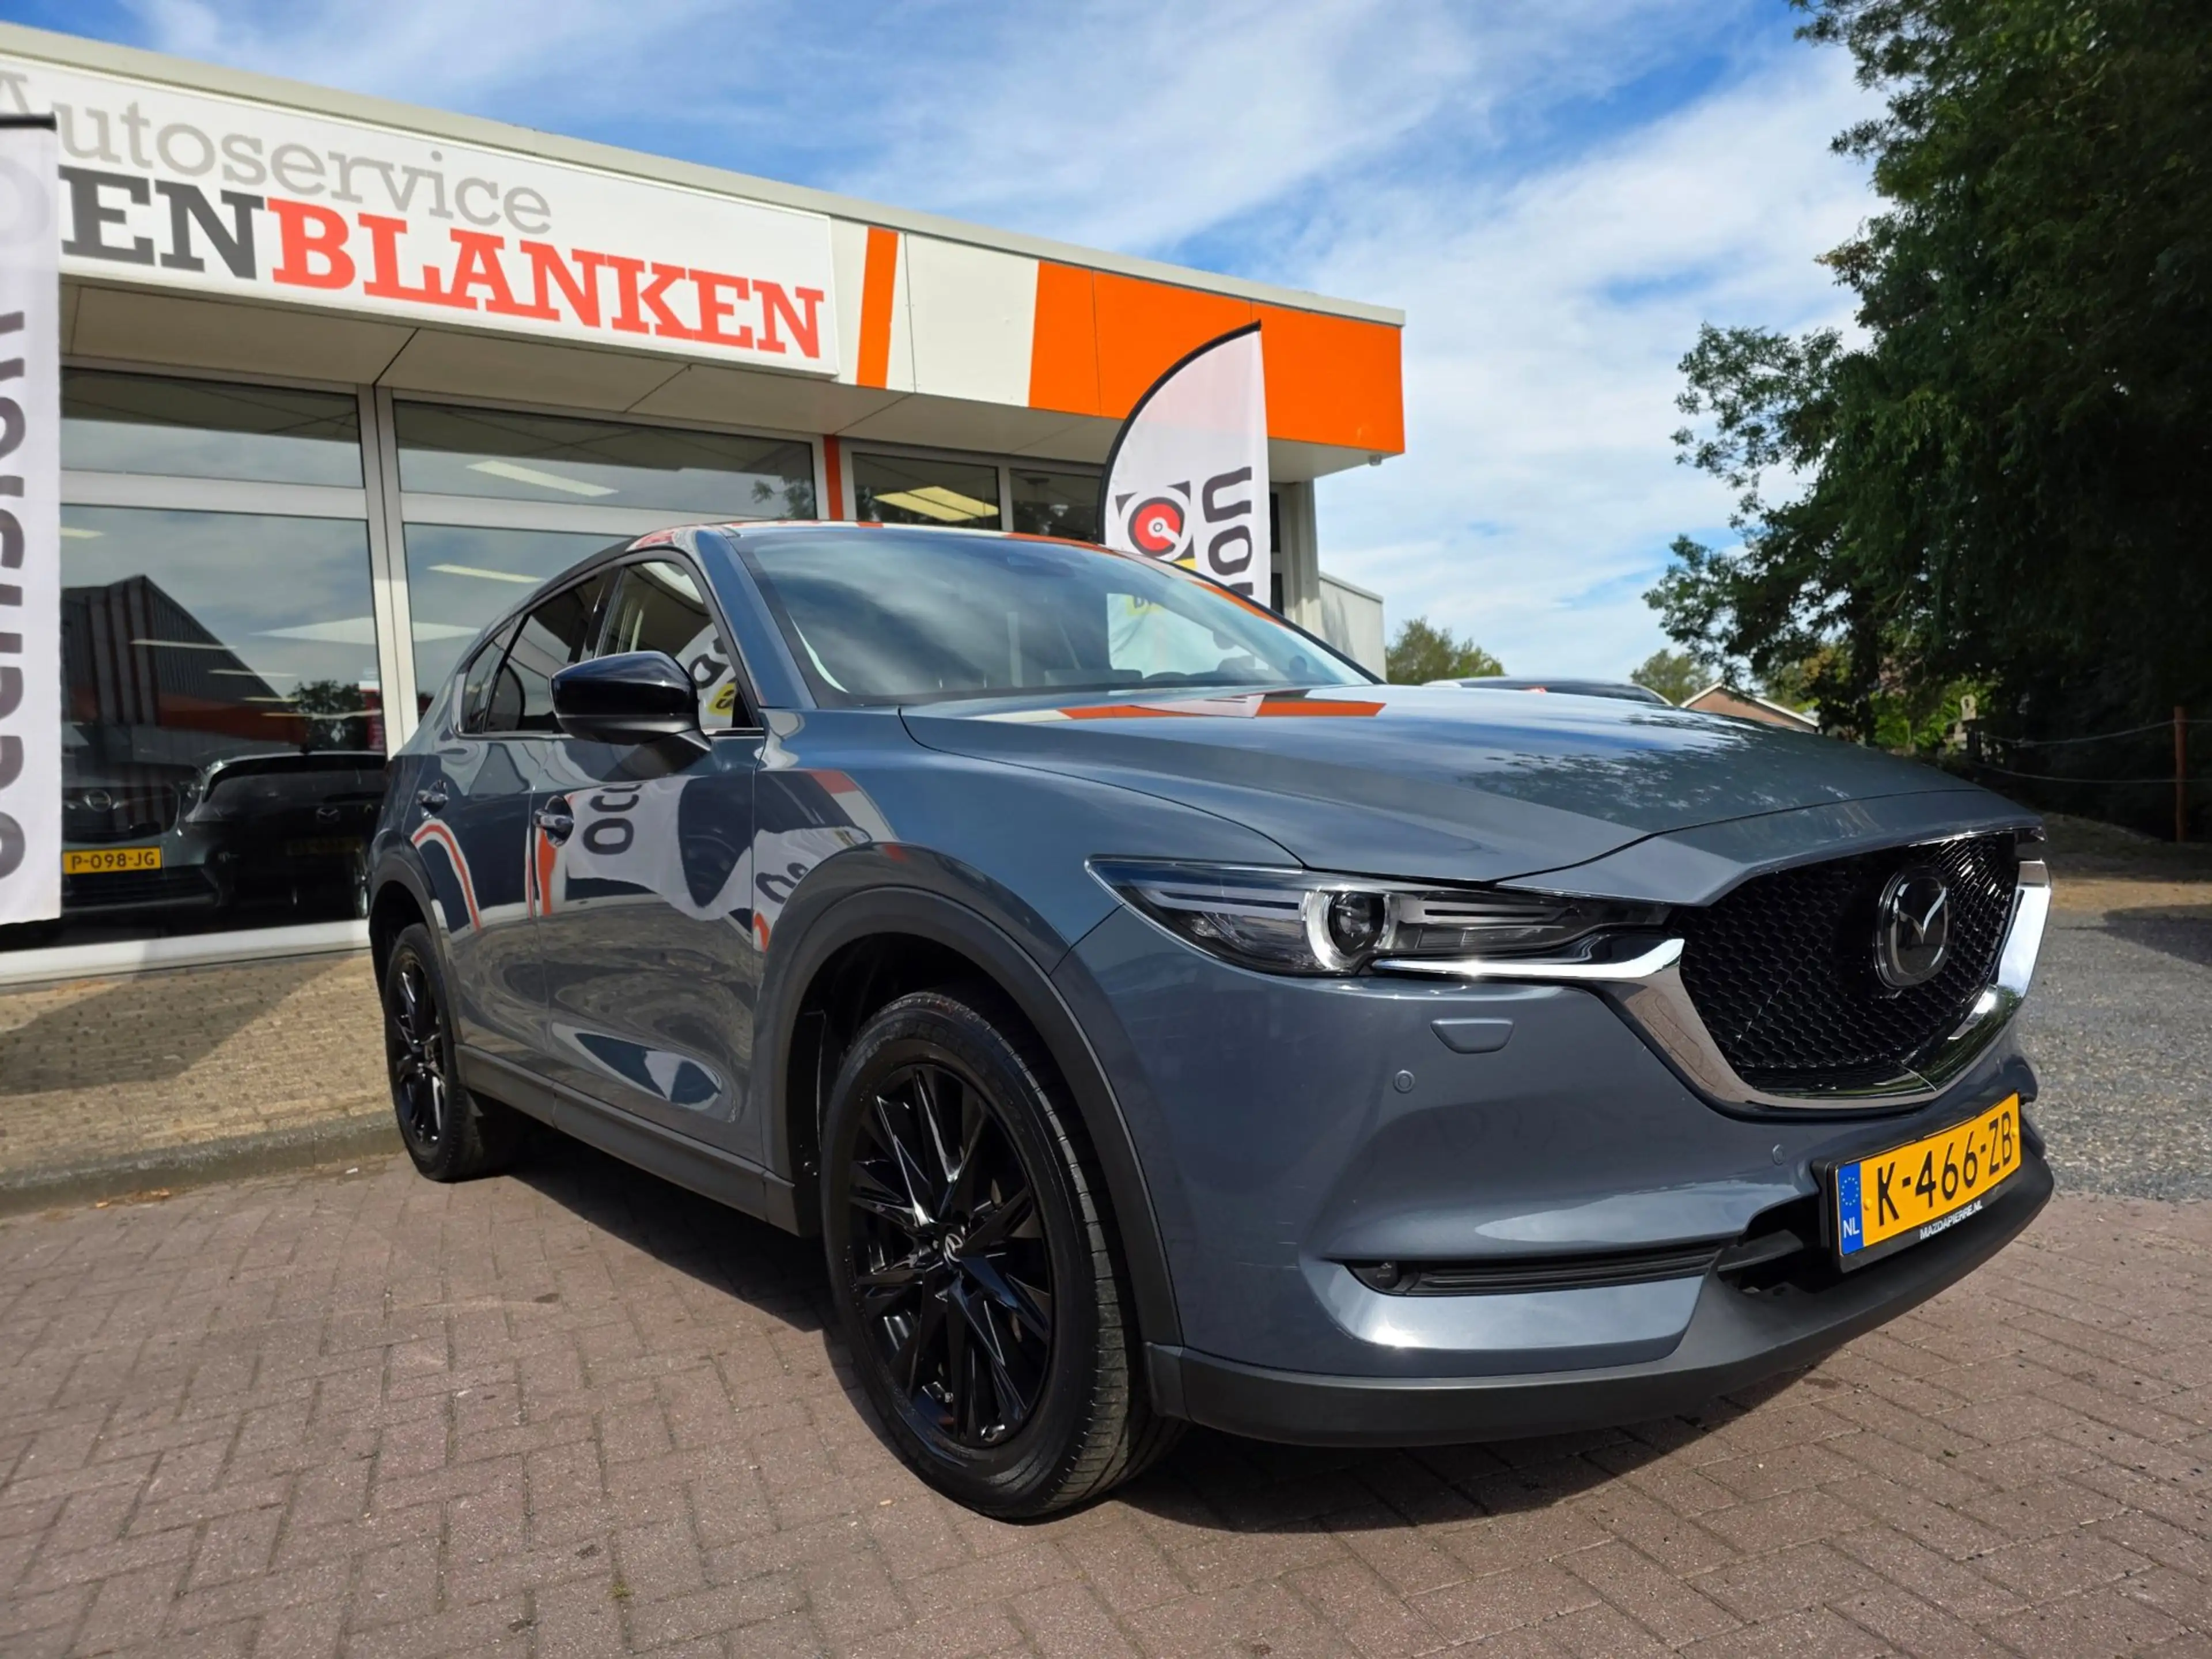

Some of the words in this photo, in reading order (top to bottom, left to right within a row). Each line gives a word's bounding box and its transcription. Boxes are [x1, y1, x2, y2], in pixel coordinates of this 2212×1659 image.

[59, 165, 824, 359] ENBLANKEN
[71, 851, 155, 871] P-098-JG
[1876, 1111, 2013, 1227] K-466-ZB
[1843, 1217, 1860, 1238] NL
